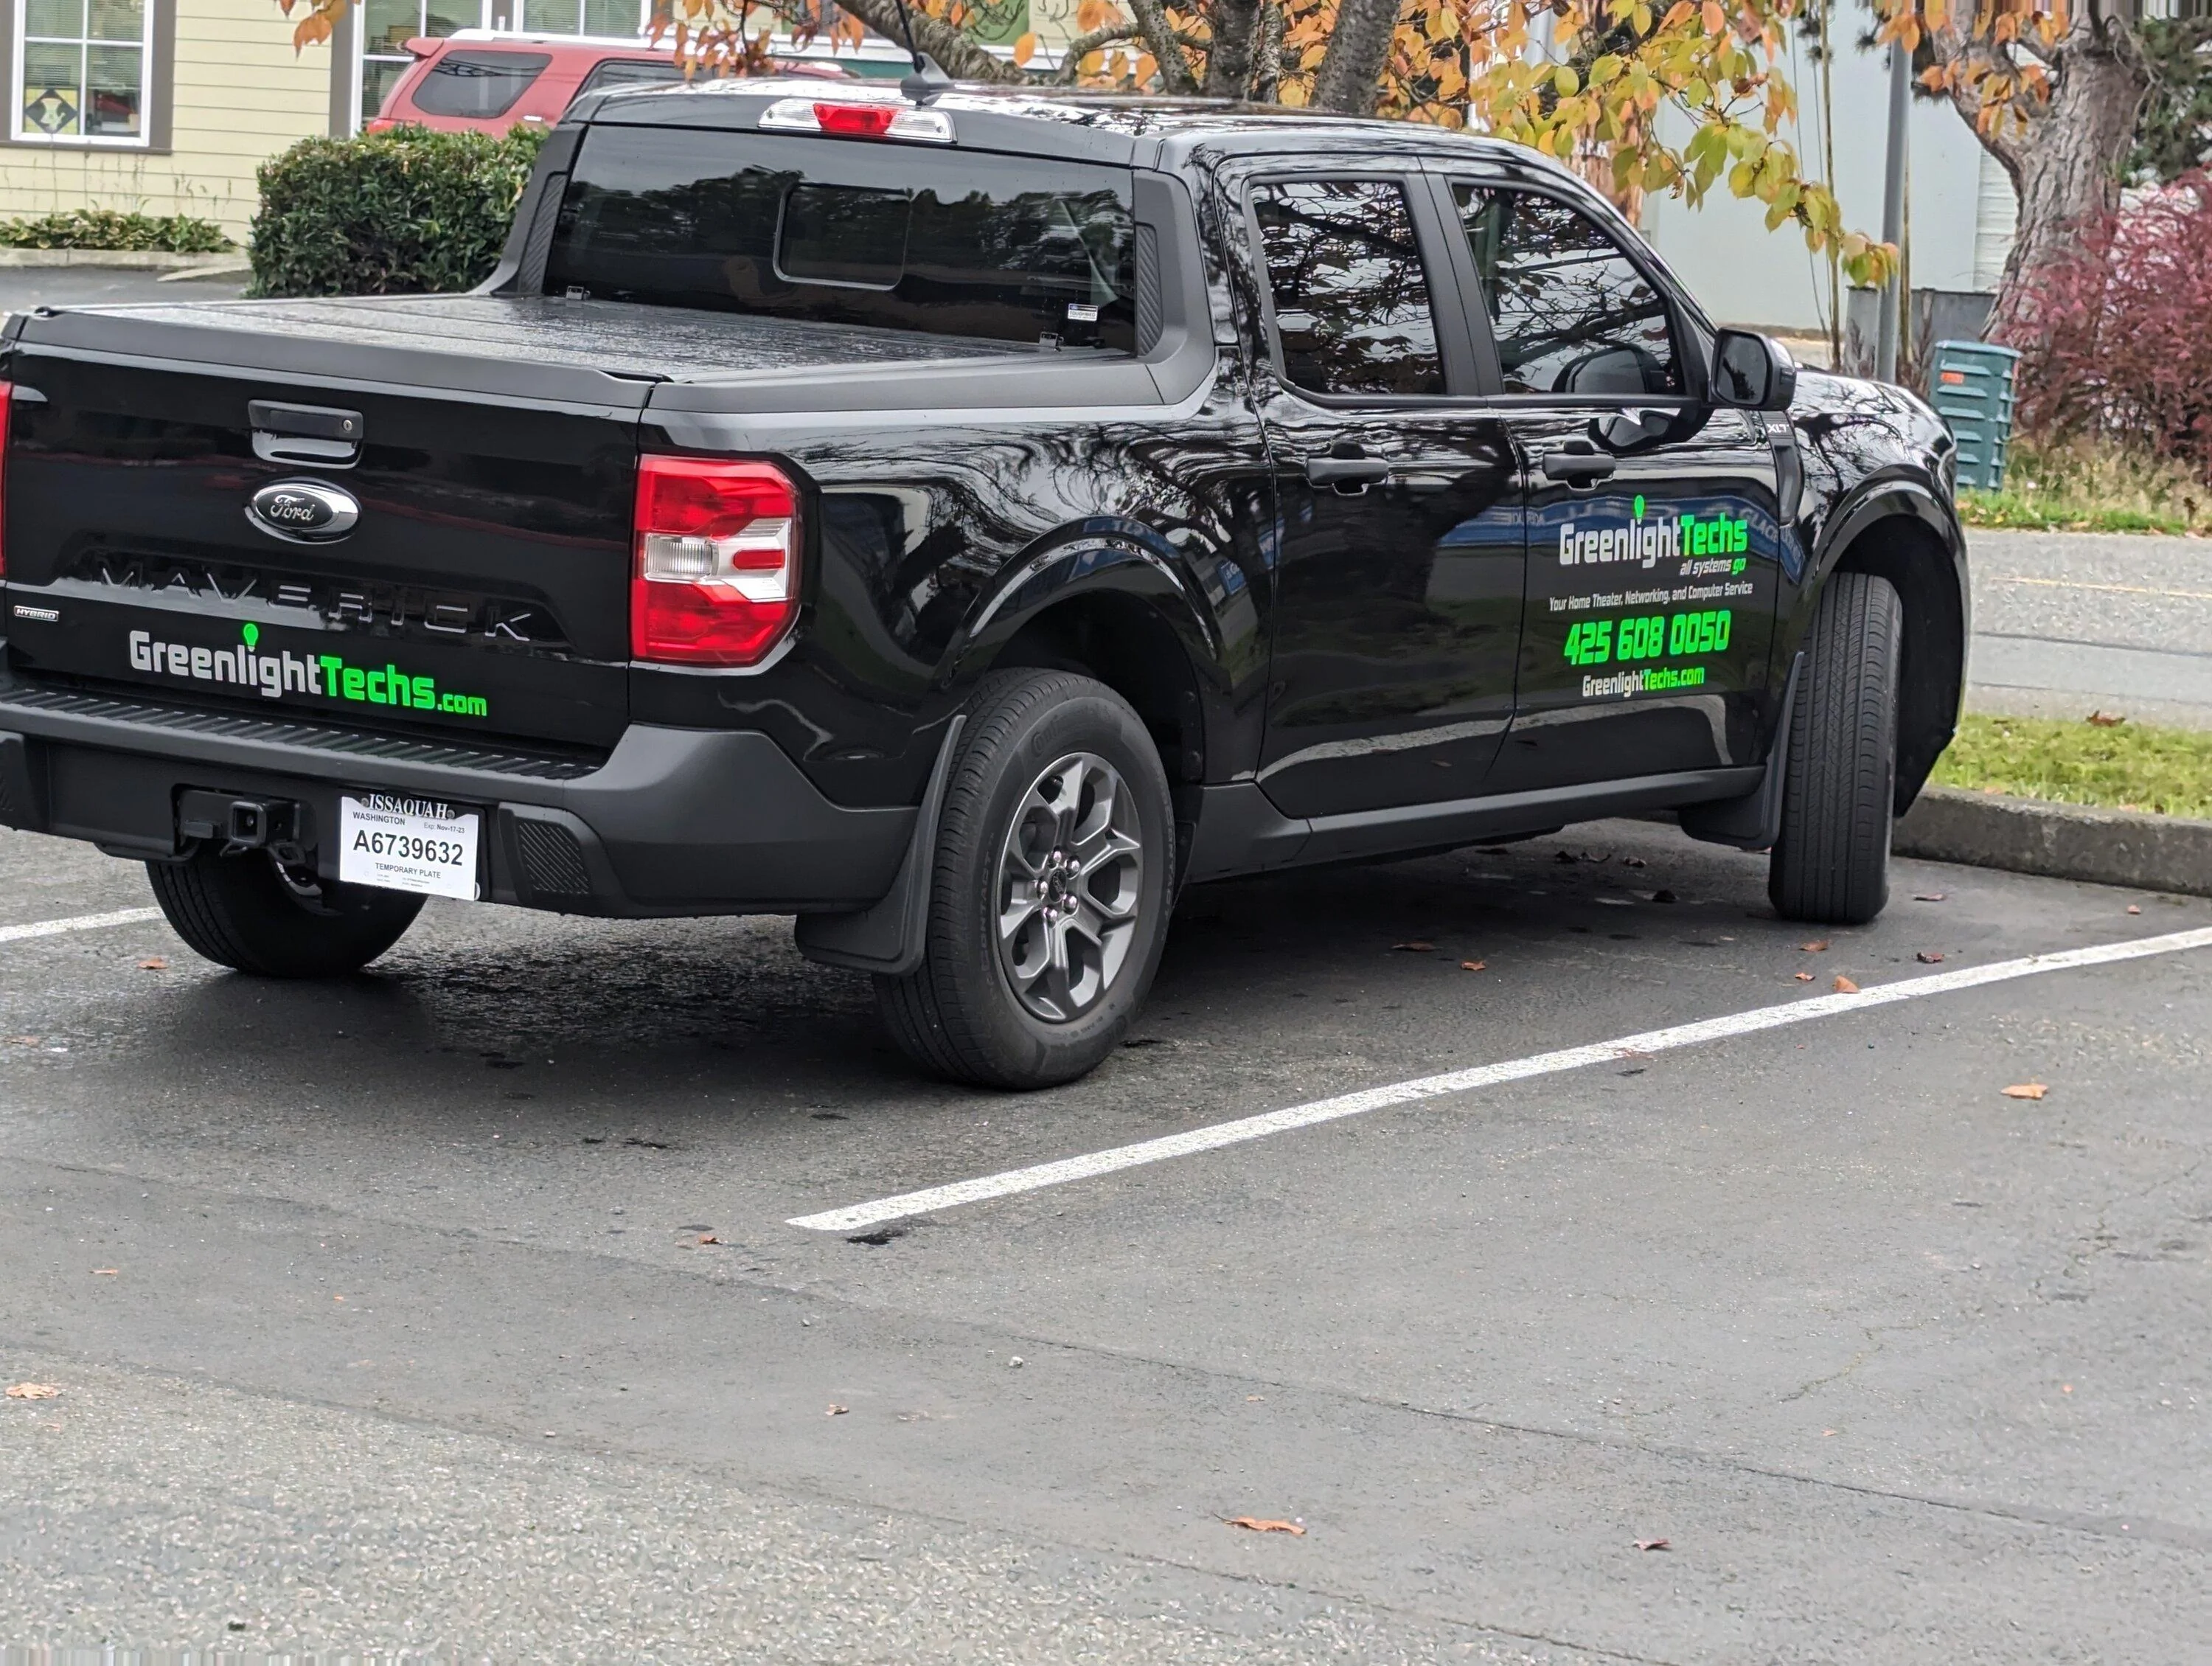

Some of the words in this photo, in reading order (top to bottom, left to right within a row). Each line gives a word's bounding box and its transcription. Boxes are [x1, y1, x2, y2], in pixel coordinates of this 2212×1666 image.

[1766, 423, 1790, 433] XLT
[270, 494, 316, 521] Ford
[1559, 495, 1747, 569] GreenlightTechs
[1680, 559, 1693, 575] all
[1693, 558, 1732, 577] systems
[1732, 558, 1747, 575] go
[99, 560, 532, 642] MAVERICK
[1550, 597, 1568, 611] Your
[1568, 595, 1590, 610] Home
[1593, 592, 1623, 608] Theater,
[1625, 588, 1671, 605] Networking,
[1672, 586, 1688, 601] and
[1688, 583, 1723, 602] Computer
[1725, 580, 1753, 596] Service
[16, 608, 56, 619] HYBRID
[1564, 620, 1613, 665] 425
[1617, 616, 1665, 661] 608
[1669, 610, 1731, 655] 0050
[130, 622, 487, 716] GreenlightTechs.com
[1582, 667, 1705, 698] GreenlightTechs.com
[352, 811, 406, 825] WASHINGTON
[369, 794, 448, 820] ISSAQUAH
[437, 824, 465, 834] Nov-17-23
[352, 830, 463, 866] A6739632
[375, 862, 419, 875] TEMPORARY
[419, 869, 442, 879] PLATE
